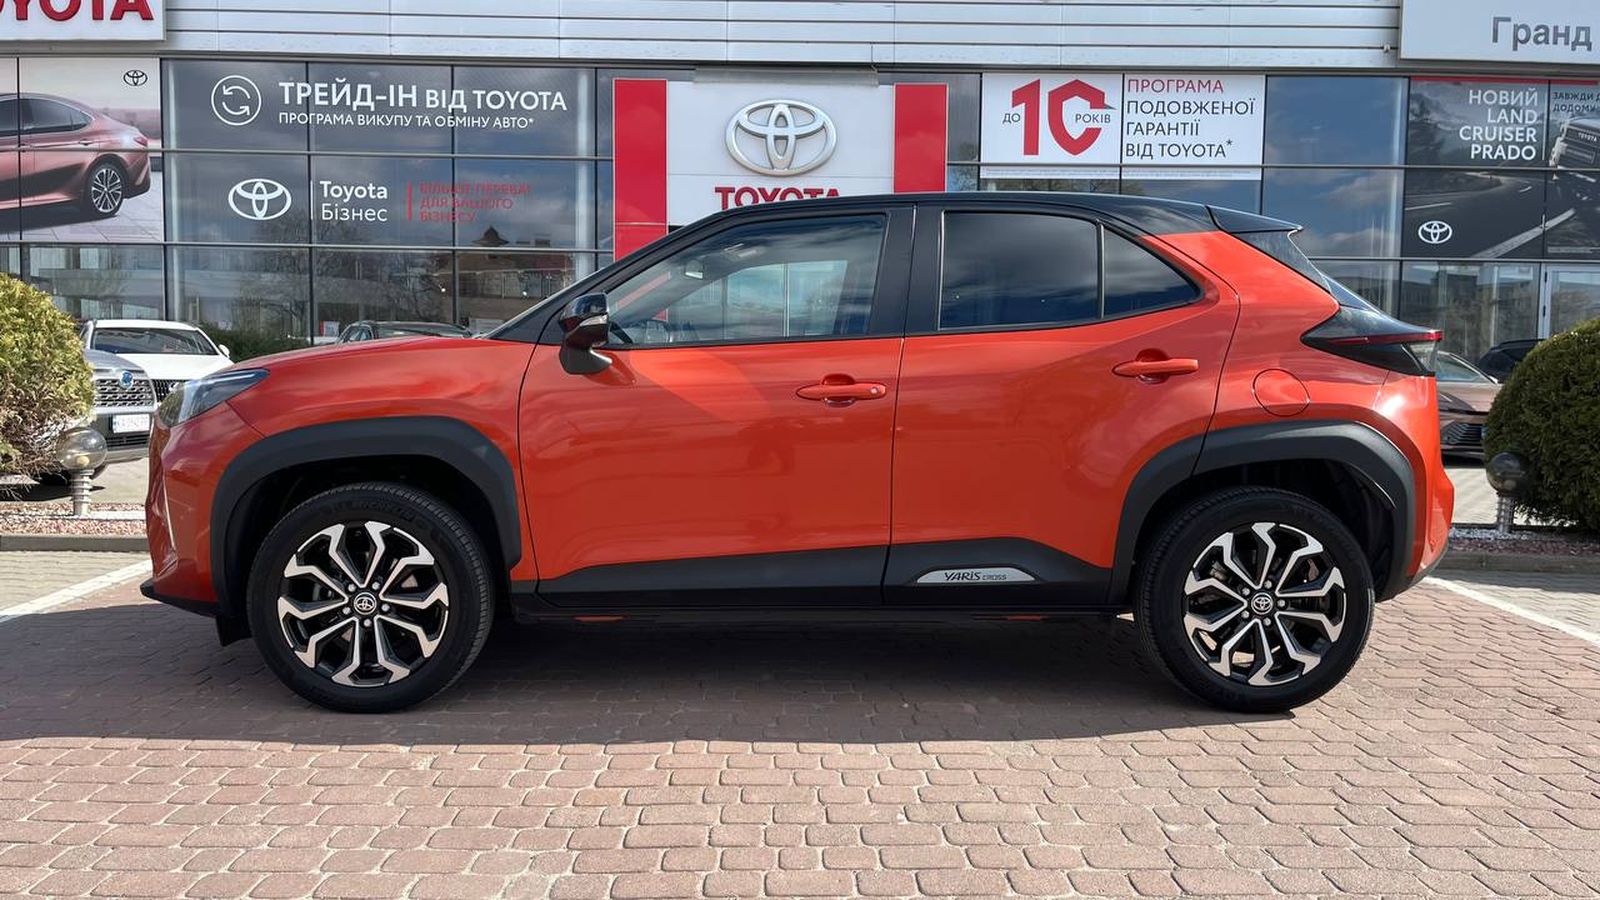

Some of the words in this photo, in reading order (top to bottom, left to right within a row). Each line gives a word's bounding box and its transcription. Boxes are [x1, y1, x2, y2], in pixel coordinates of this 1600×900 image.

[1492, 17, 1592, 51] Гранд
[1127, 79, 1224, 93] ПРОГРАМА
[279, 77, 417, 111] ТРЕЙД-ІН
[425, 89, 467, 113] ВІД
[472, 90, 567, 111] TOYOTA
[1468, 87, 1538, 106] НОВИЙ
[1126, 98, 1256, 118] ПОДОВЖЕНОЇ
[1486, 108, 1538, 124] LAND
[279, 112, 354, 125] ПРОГРАМА
[357, 114, 412, 127] ВИКУПУ
[415, 115, 432, 126] ТА
[434, 115, 490, 128] ОБМІНУ
[1002, 113, 1021, 124] ДО
[1075, 113, 1111, 124] РОКІВ
[1126, 119, 1201, 136] ГАРАНТІЇ
[1459, 125, 1537, 142] CRUISER
[1125, 143, 1154, 160] ВІД
[1470, 144, 1537, 160] PRADO
[319, 180, 388, 203] Toyota
[321, 203, 388, 222] Бізнес
